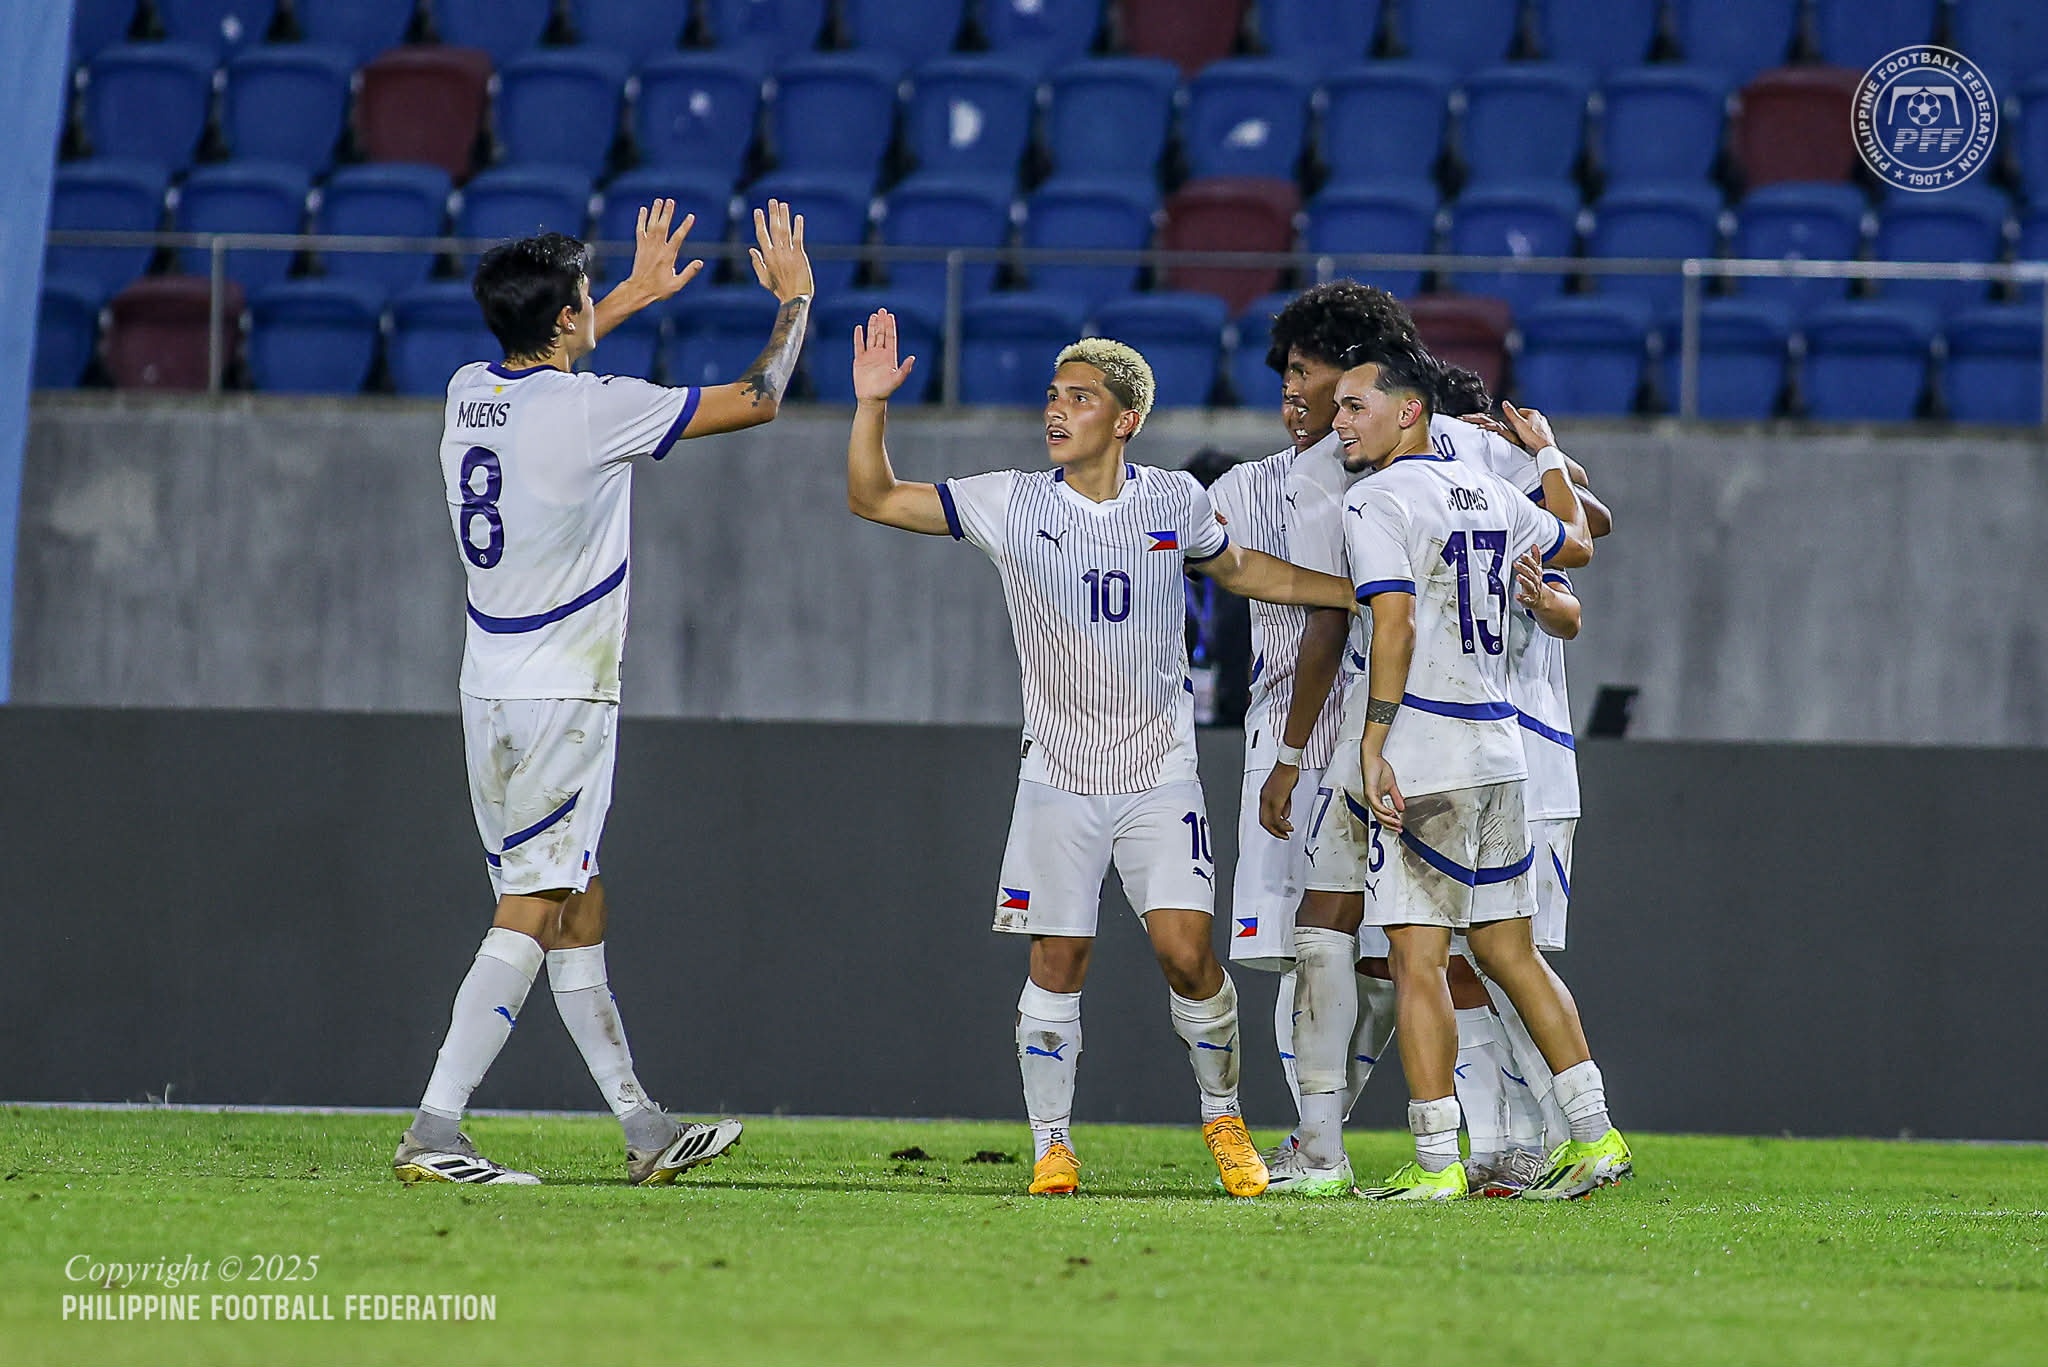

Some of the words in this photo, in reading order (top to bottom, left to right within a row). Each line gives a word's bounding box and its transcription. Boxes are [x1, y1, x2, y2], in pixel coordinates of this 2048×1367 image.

[457, 401, 510, 428] MUENS
[460, 446, 504, 569] 8
[1081, 569, 1131, 623] 10
[1440, 530, 1508, 656] 13
